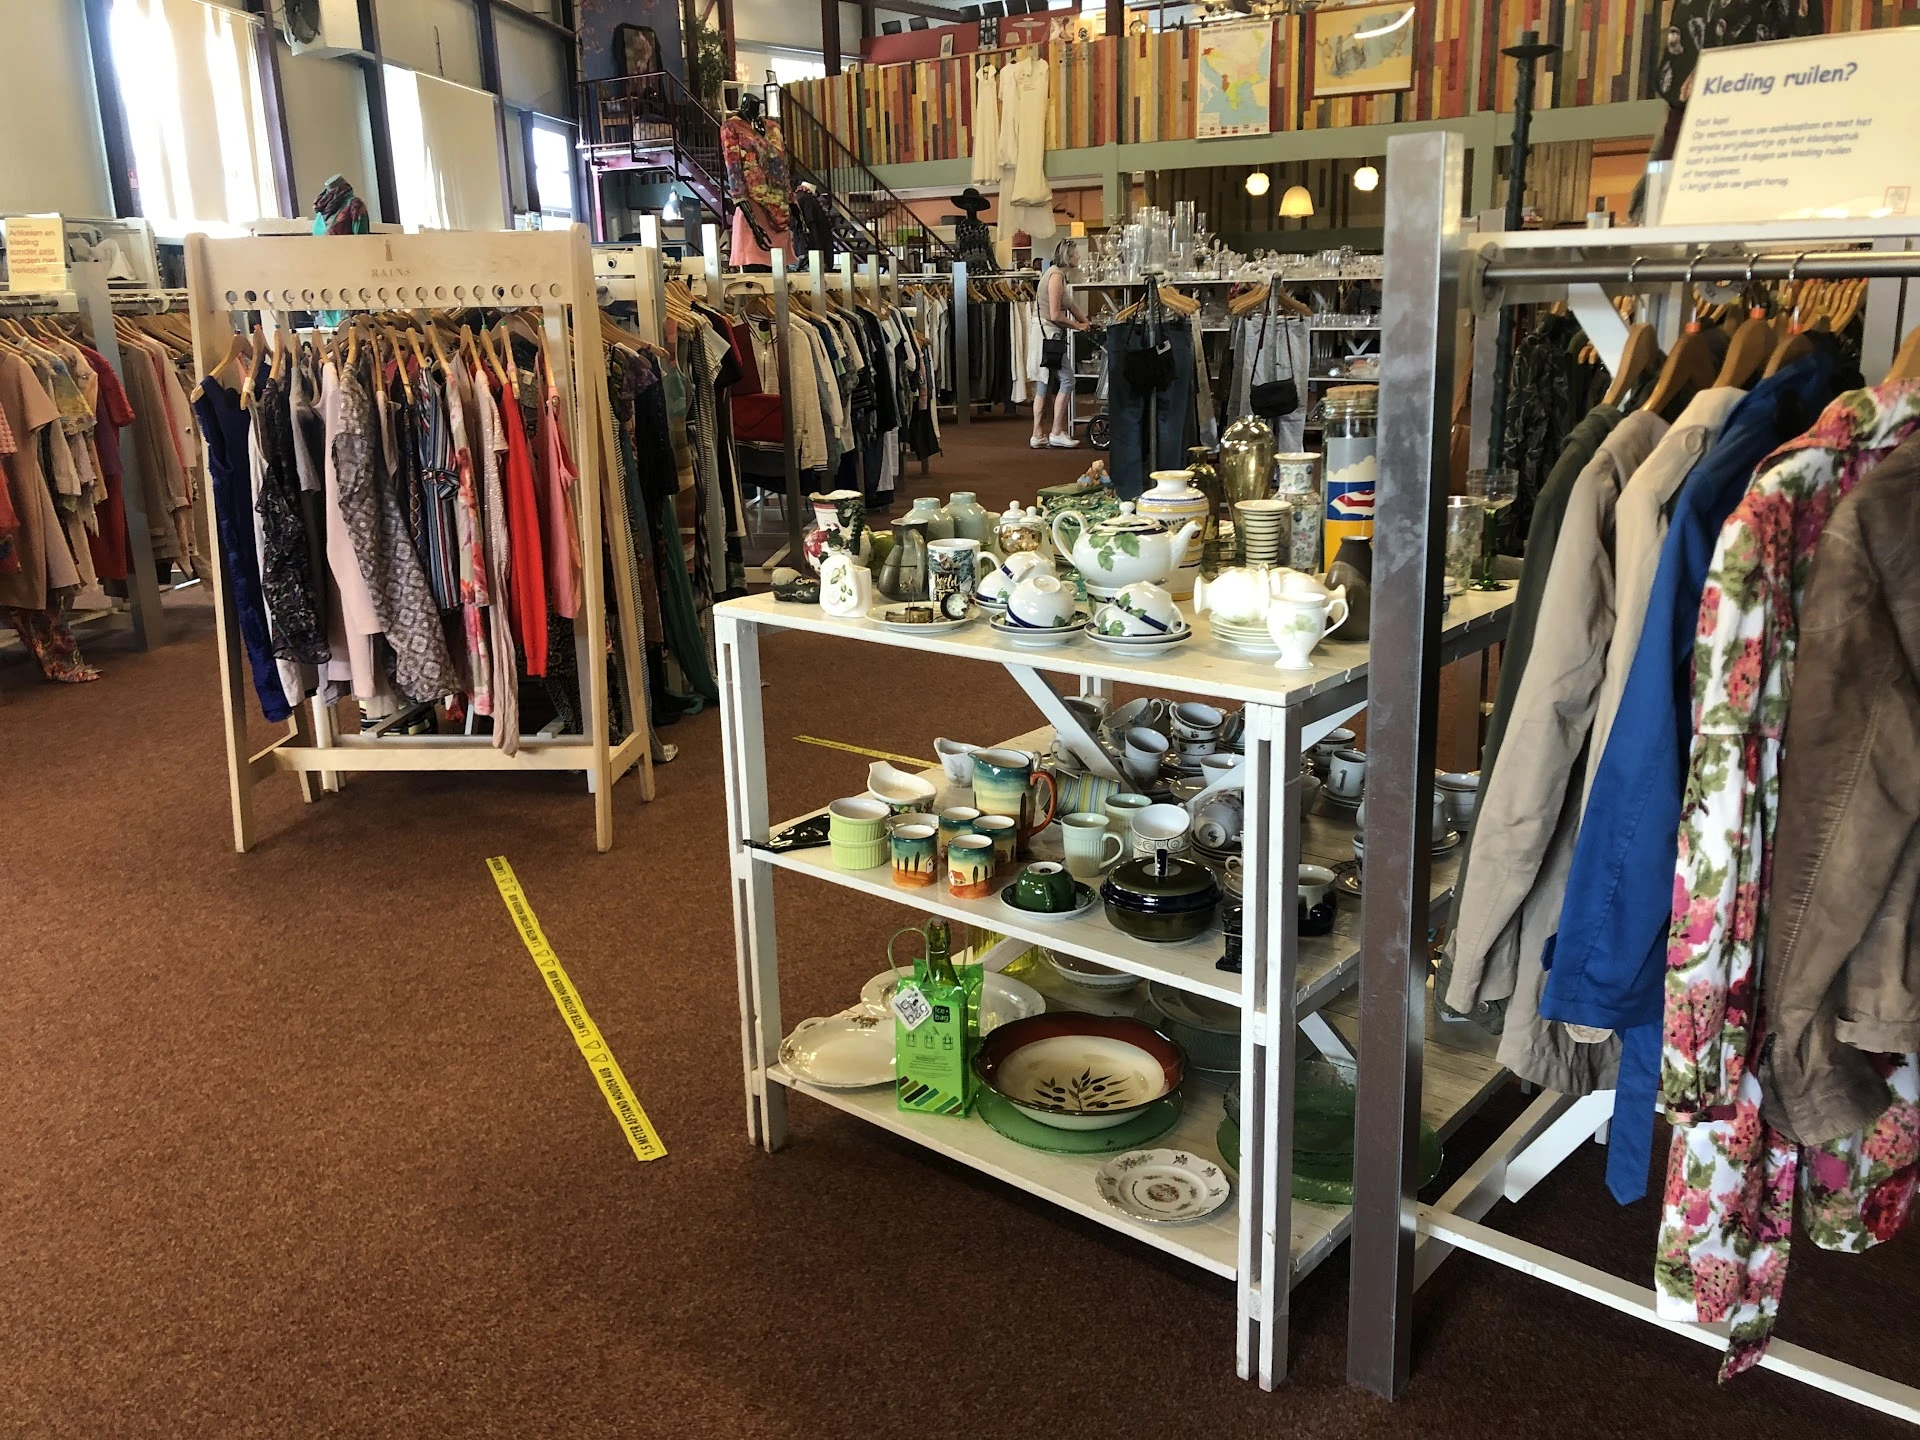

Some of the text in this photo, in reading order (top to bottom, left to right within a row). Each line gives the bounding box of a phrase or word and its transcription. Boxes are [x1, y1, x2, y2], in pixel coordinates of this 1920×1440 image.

[1703, 62, 1858, 95] Kleding ruilen?
[934, 1014, 949, 1023] bag
[598, 1068, 614, 1078] AUB
[604, 1078, 626, 1100] HOUDEN
[616, 1100, 638, 1125] AFSTAND
[630, 1124, 650, 1146] METER
[640, 1145, 656, 1156] 1,5
